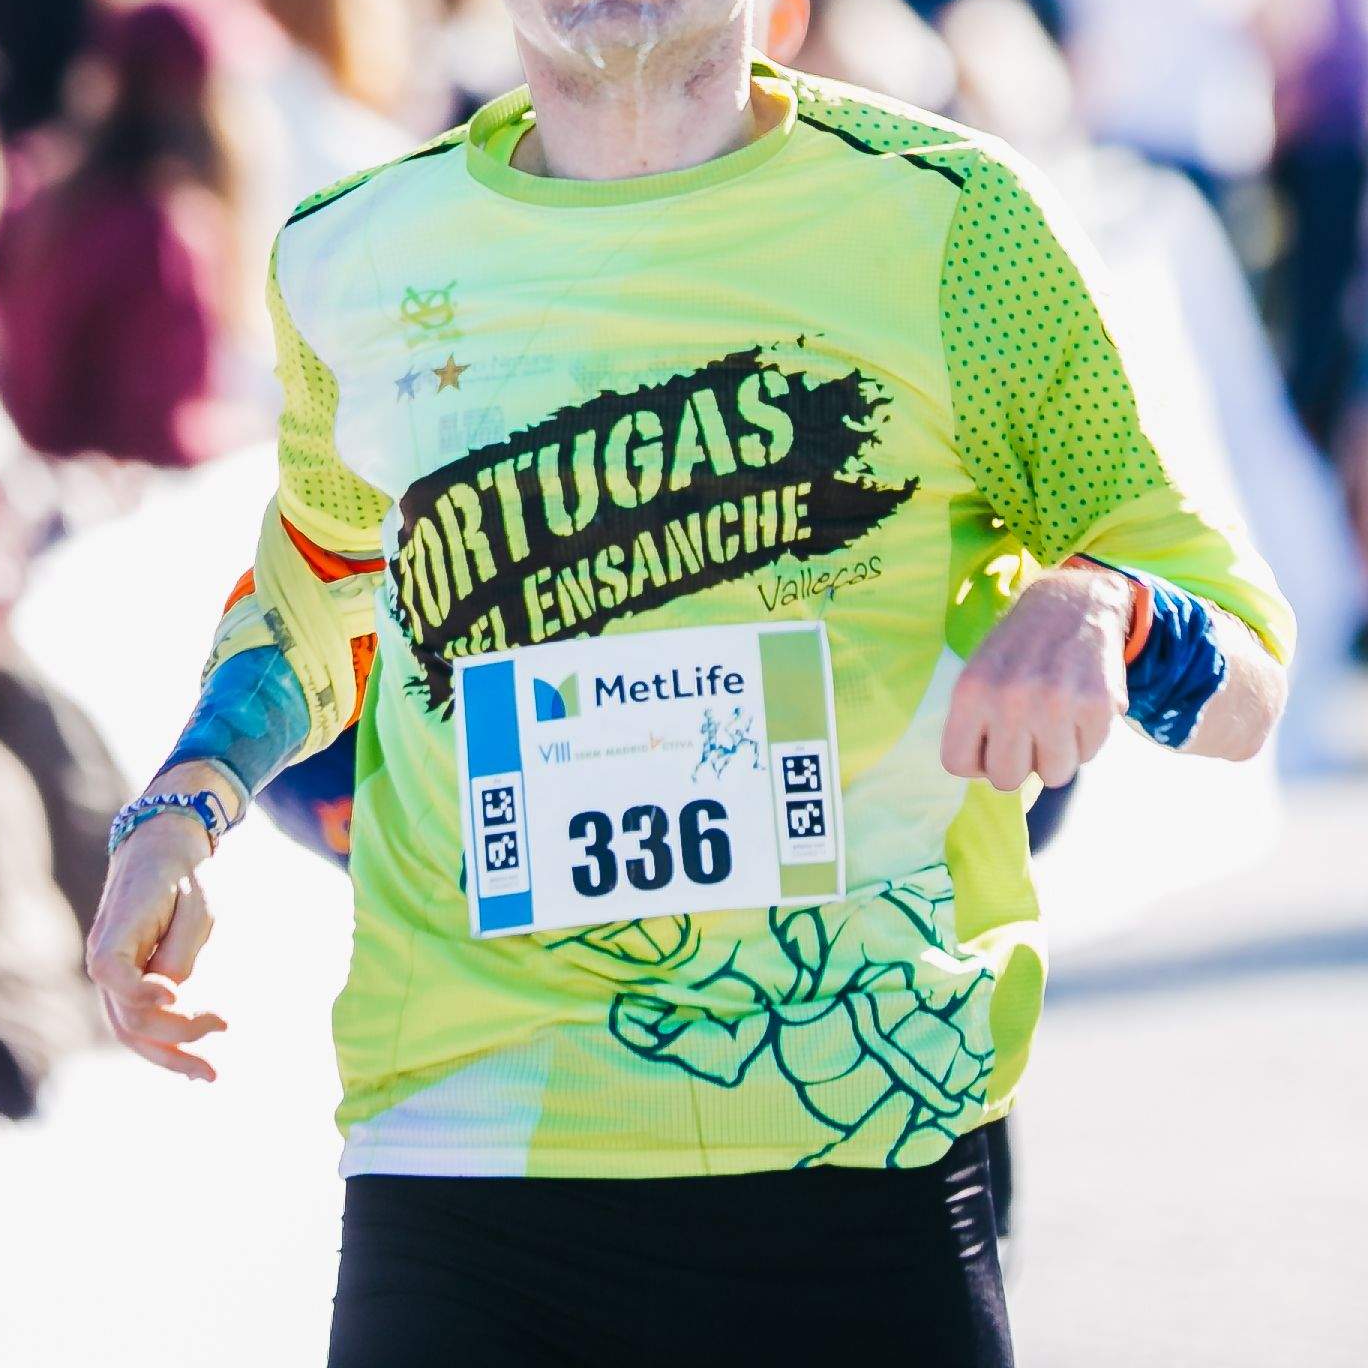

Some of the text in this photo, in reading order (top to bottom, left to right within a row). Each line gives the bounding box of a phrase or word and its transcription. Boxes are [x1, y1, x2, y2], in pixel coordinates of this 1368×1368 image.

[522, 482, 813, 643] ENSANCHE
[757, 555, 881, 612] Vallecas
[594, 665, 745, 707] MetLife
[538, 741, 571, 764] VIII
[568, 798, 732, 898] 336
